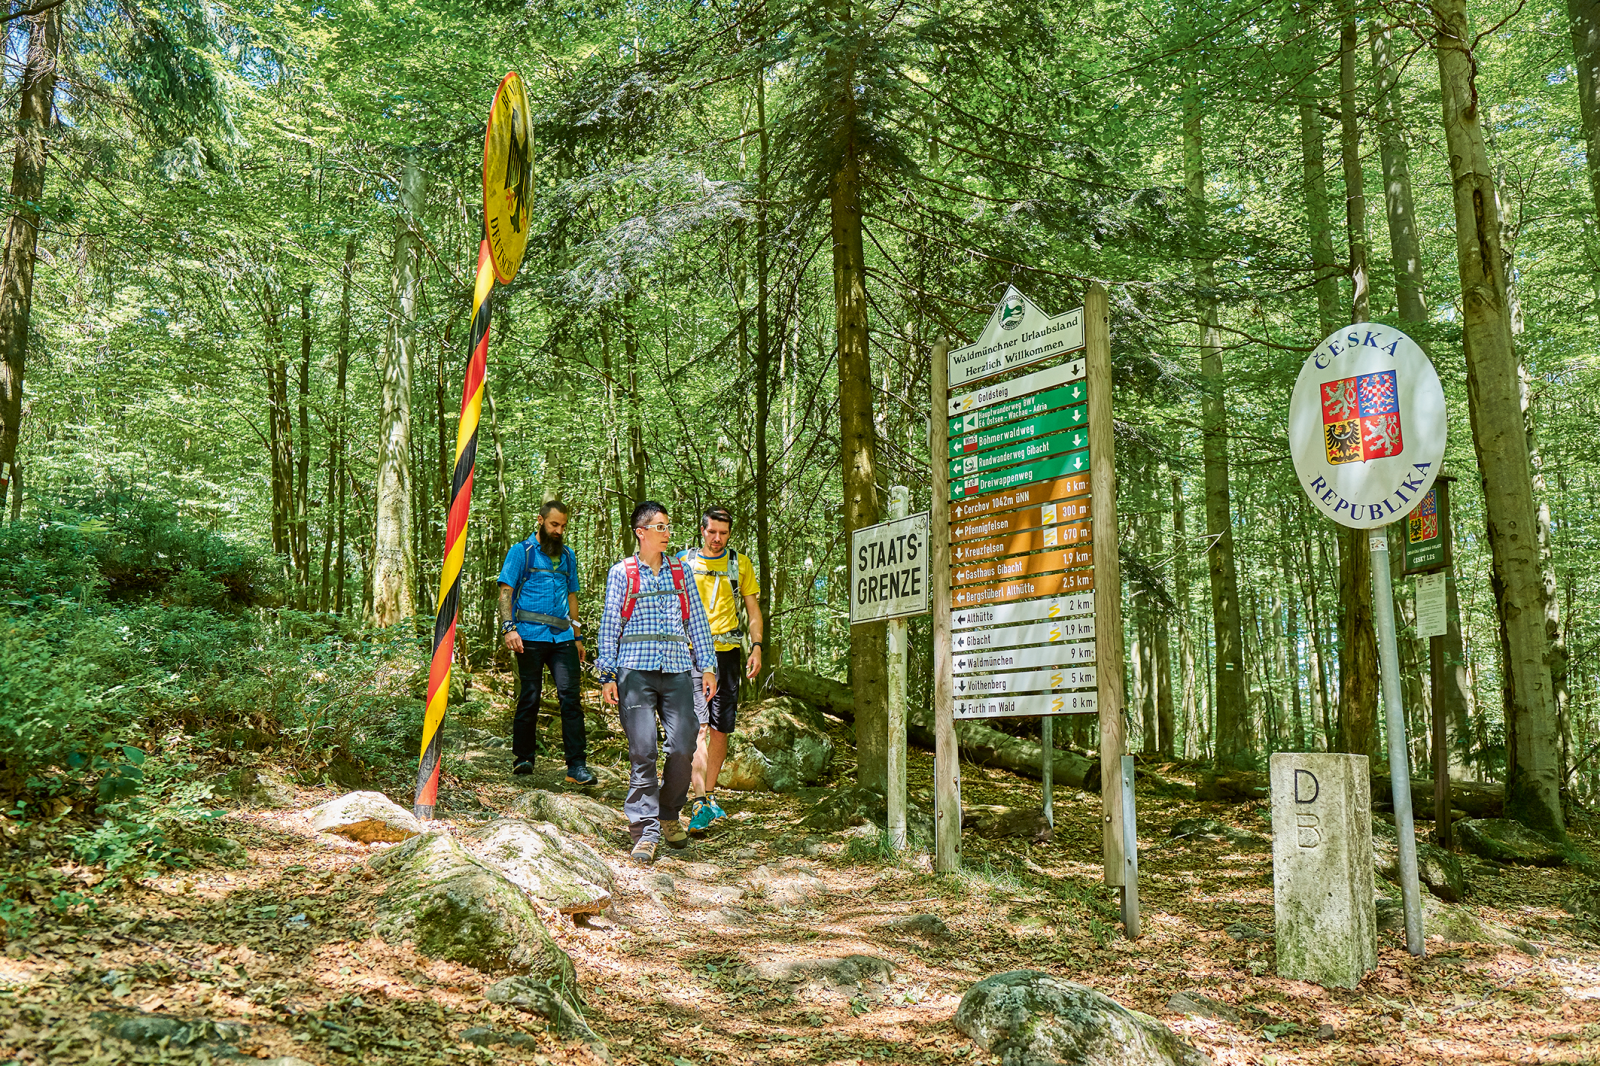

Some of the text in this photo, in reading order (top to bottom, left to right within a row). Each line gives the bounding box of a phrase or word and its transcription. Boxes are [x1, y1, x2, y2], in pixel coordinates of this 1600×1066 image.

[953, 316, 1078, 365] Waldmünchner Urlaubsland
[1313, 331, 1404, 370] ČESKÁ
[965, 339, 1064, 377] Herzlich Willkommen
[978, 389, 1009, 403] Goldsteig
[978, 397, 1036, 420] Hauptwanderweg BWV
[978, 420, 985, 428] E6
[986, 416, 1003, 427] Ostsee
[1009, 411, 1027, 423] Wachau
[1033, 404, 1047, 416] Adria
[979, 424, 1035, 447] Böhmerwaldweg
[978, 442, 1050, 468] Rundwanderweg Gibacht
[980, 470, 1033, 490] Dreiwappenweg
[1310, 461, 1432, 521] REPUBLIKA
[963, 480, 1086, 515] Cerchov 1042m üNN 6 km
[964, 506, 1086, 535] Pfennigfelsen 300 m
[858, 533, 922, 571] STAATS-
[964, 529, 1087, 557] Kreuzfelsen 670 m
[965, 551, 1088, 580] Gasthaus Gibacht 1,9 km
[858, 566, 921, 605] GRENZE
[966, 575, 1089, 603] Bergstüberl Althütte 2,5 km
[967, 599, 1090, 624] Althütte 2 km
[967, 624, 1091, 646] Gibacht 1,9 km
[967, 648, 1091, 668] Waldmünchen 9 km
[967, 672, 1092, 691] Voithenberg 5 km
[968, 697, 1093, 714] Furth im Wald 8 km
[1294, 768, 1320, 804] D
[1295, 812, 1322, 849] B
